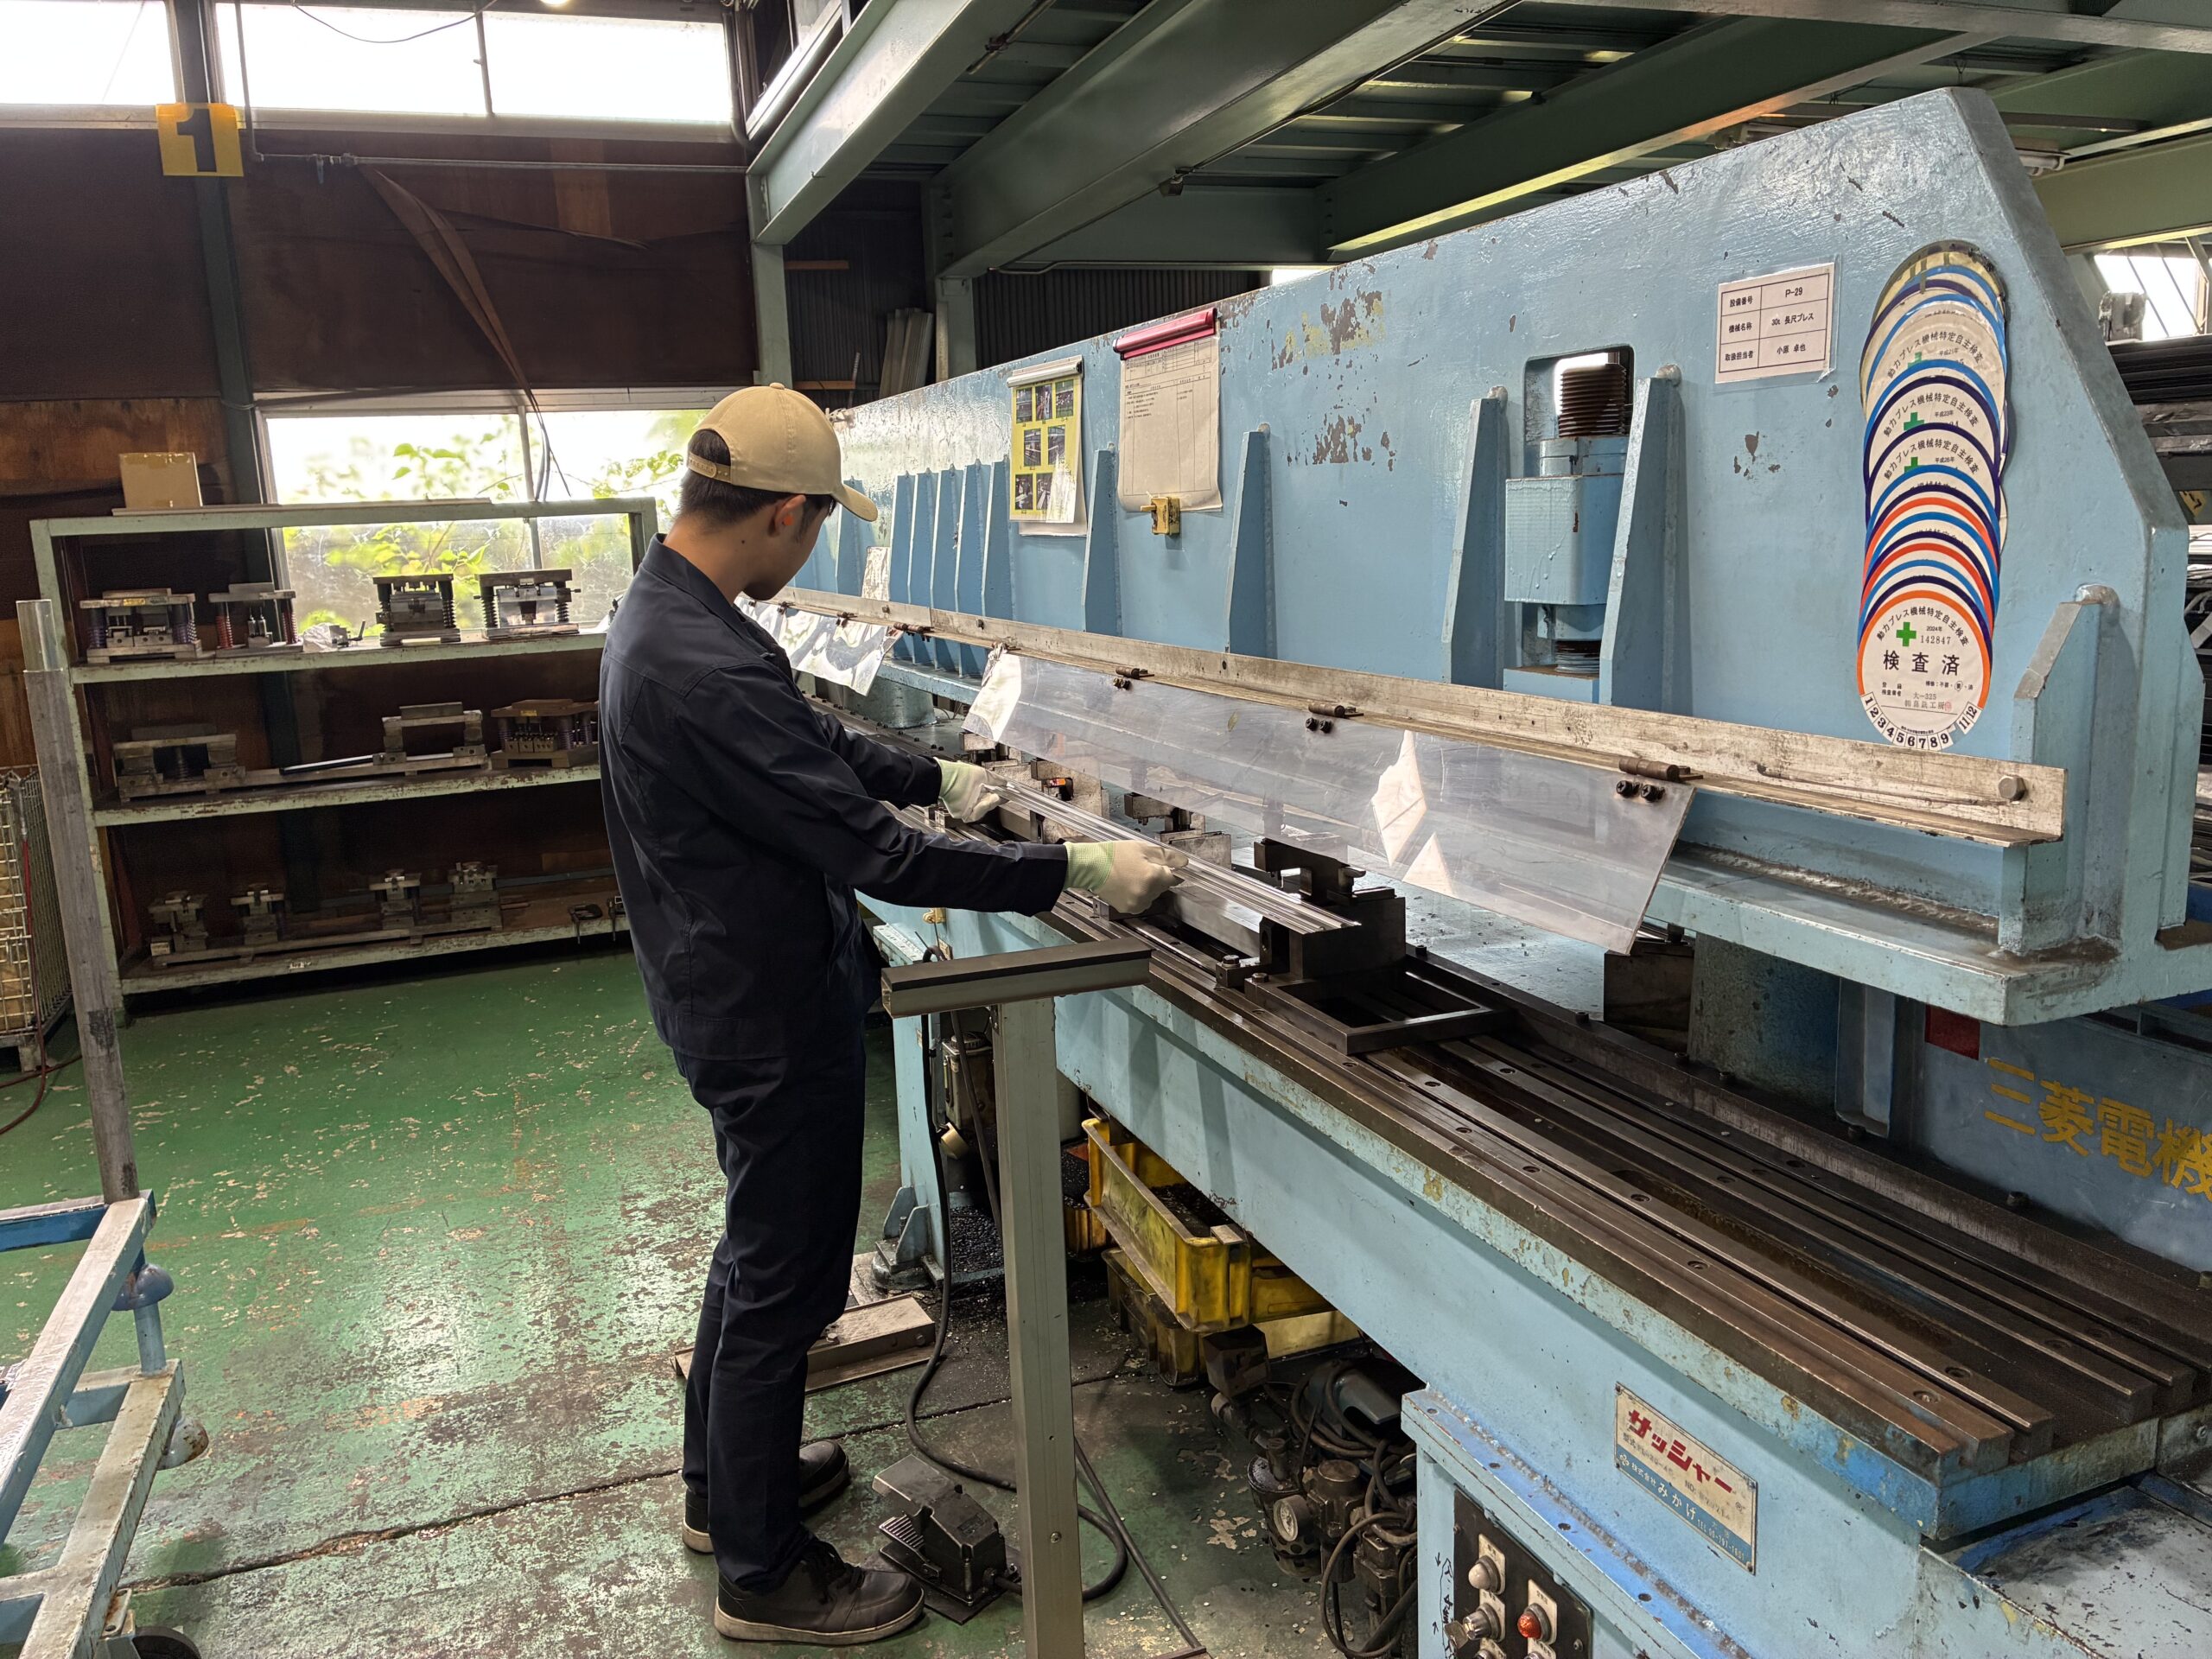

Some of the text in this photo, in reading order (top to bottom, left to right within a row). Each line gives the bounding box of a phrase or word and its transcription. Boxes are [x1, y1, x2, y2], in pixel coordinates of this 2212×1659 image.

[175, 107, 218, 173] 1
[1785, 287, 1803, 297] P-29
[1877, 607, 1969, 647] 動力プレス機械特定自主検査
[1921, 635, 1951, 645] 142847
[1883, 650, 1960, 676] 検査済
[1984, 1057, 2212, 1203] 三菱電機
[1628, 1408, 1733, 1494] サッシャー
